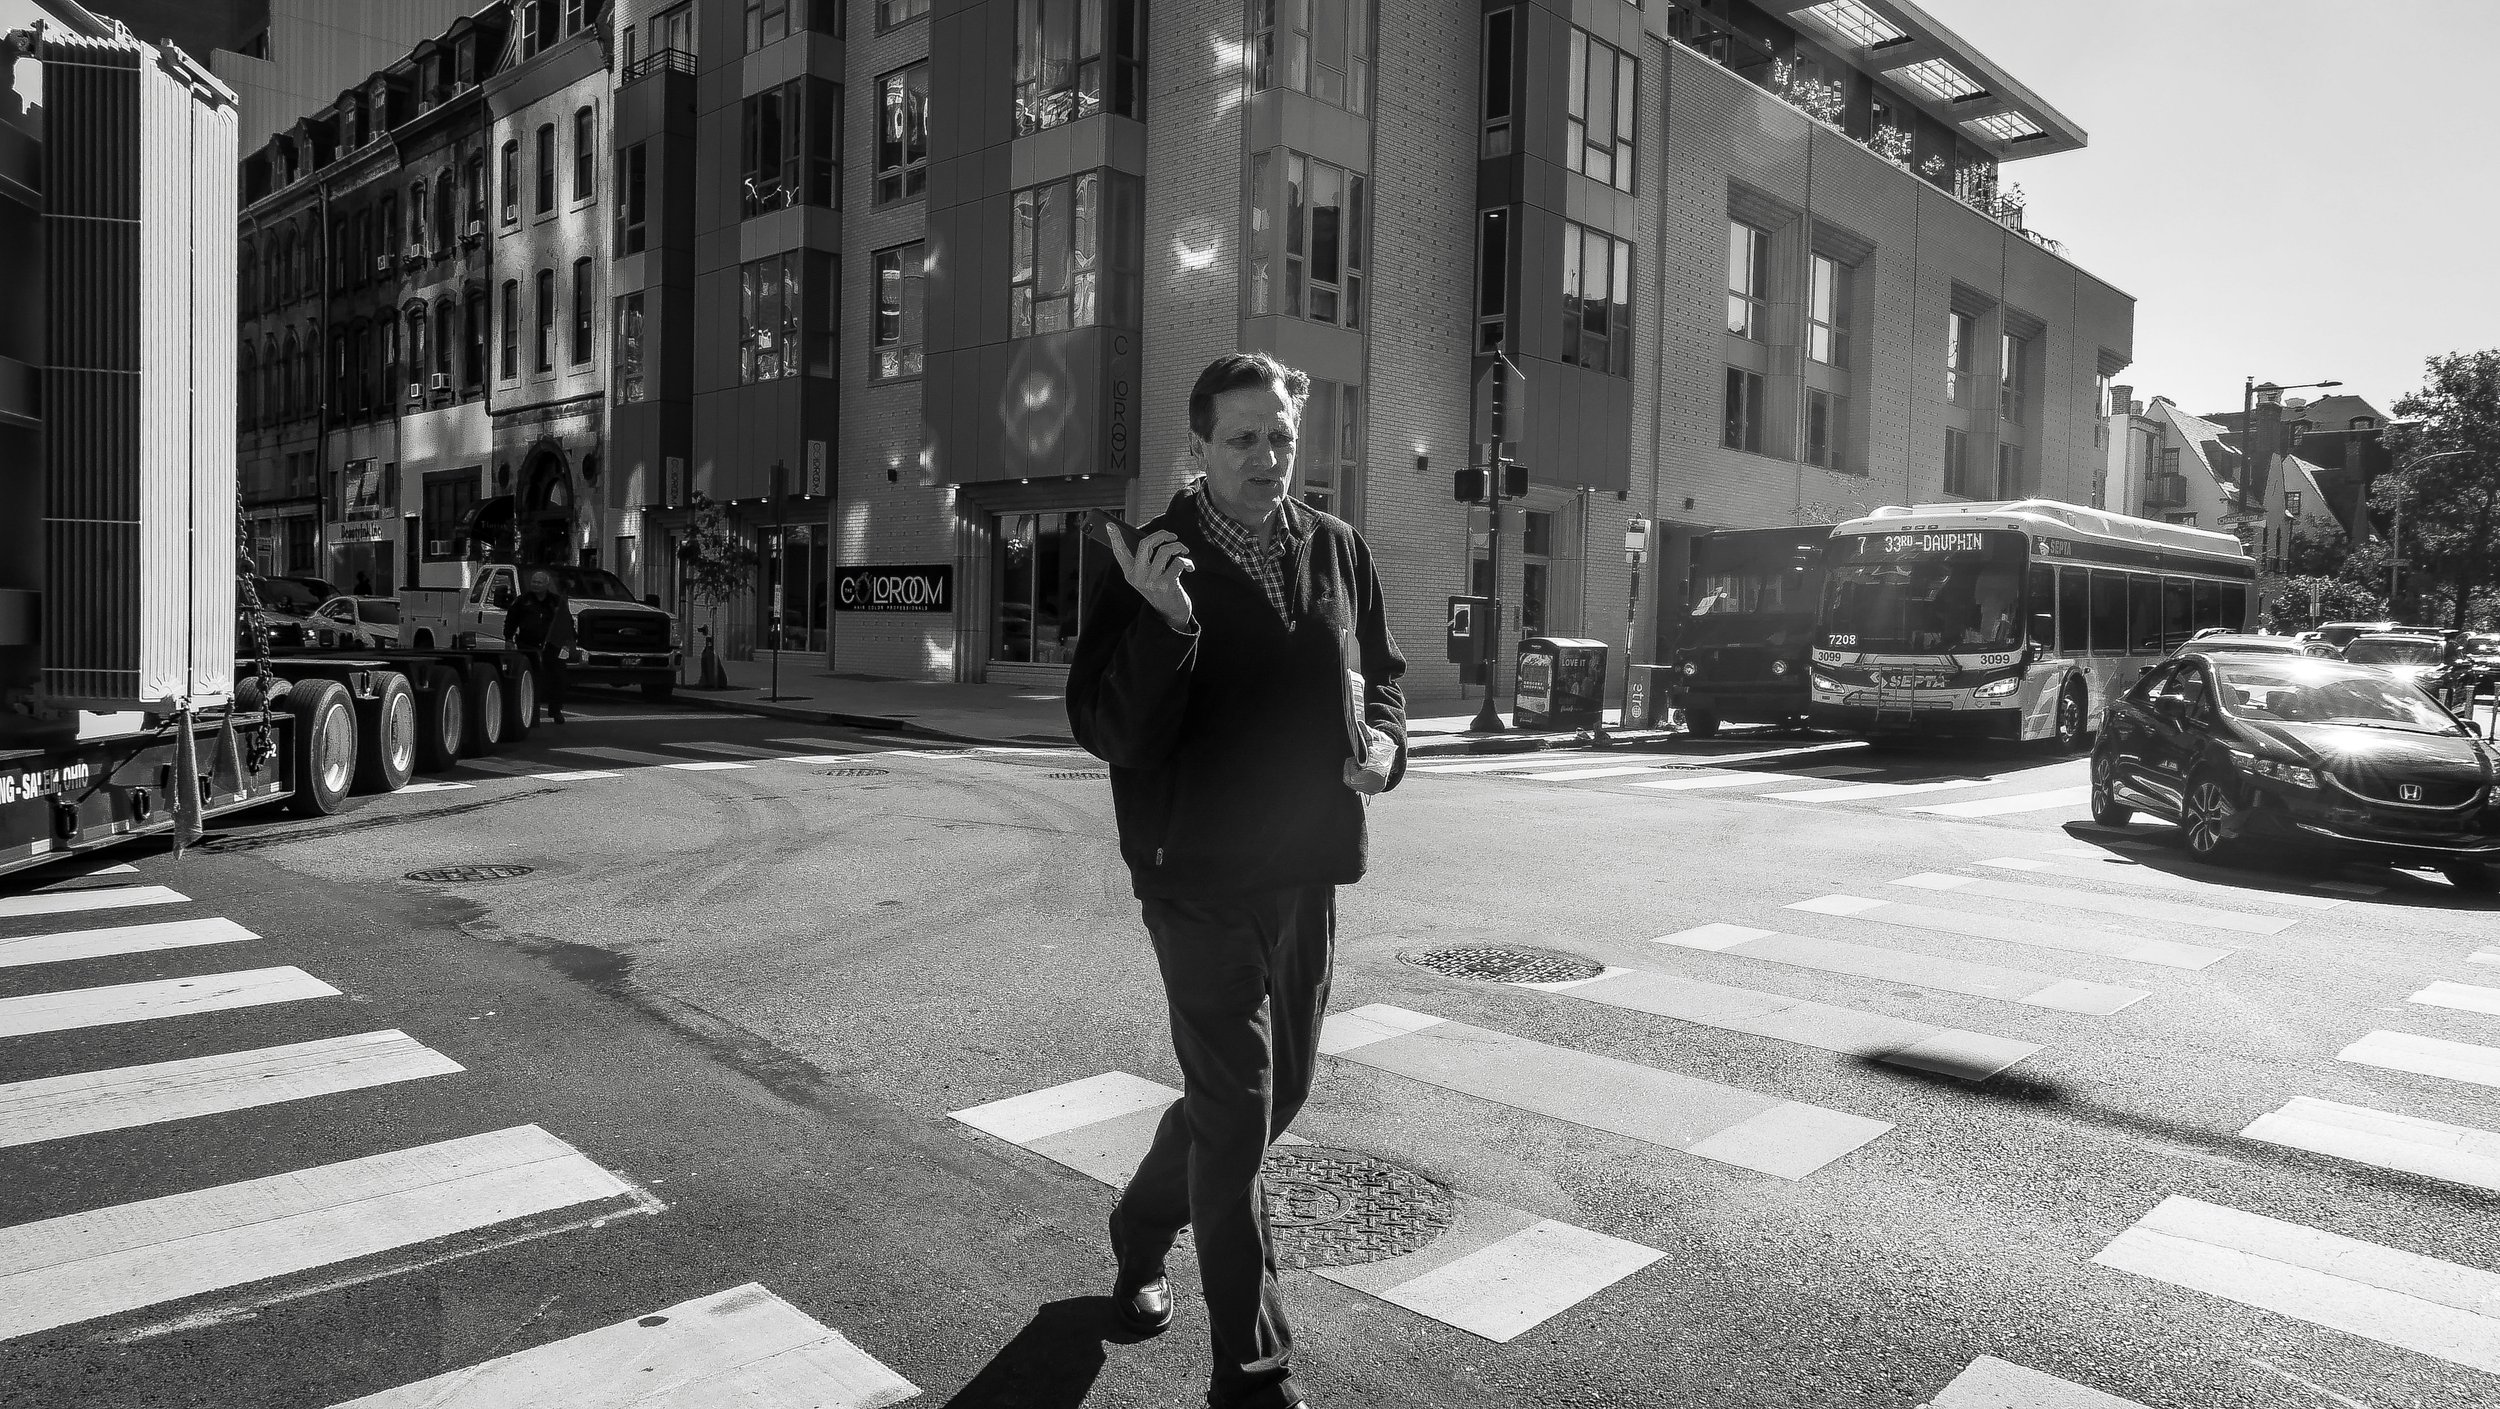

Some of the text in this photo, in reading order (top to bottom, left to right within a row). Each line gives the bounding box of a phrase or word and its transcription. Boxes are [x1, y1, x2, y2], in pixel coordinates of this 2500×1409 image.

[2218, 515, 2259, 525] CHANCELLOR
[1857, 536, 1867, 554] 7
[2050, 540, 2072, 555] SEPTA
[1828, 634, 1857, 645] 7208
[1561, 658, 1586, 667] LOVE IT
[1817, 652, 1842, 662] 3099
[1979, 654, 2011, 665] 3099
[1889, 674, 1946, 688] SEPTA
[63, 763, 89, 790] OHIO
